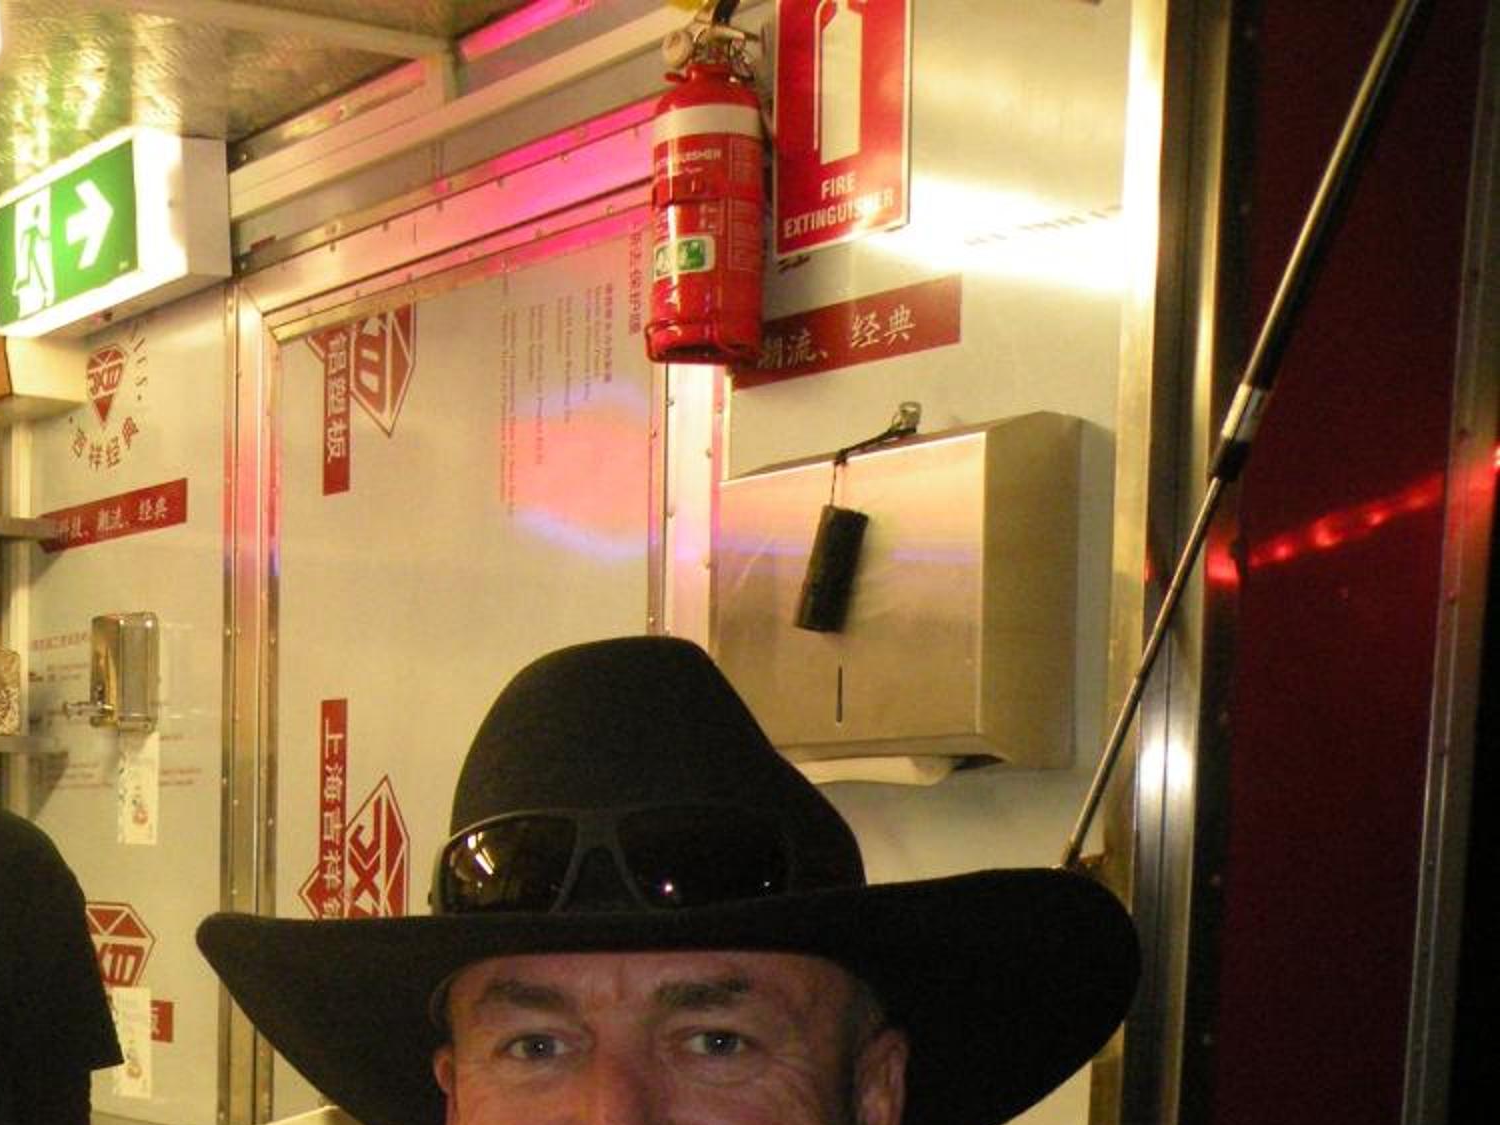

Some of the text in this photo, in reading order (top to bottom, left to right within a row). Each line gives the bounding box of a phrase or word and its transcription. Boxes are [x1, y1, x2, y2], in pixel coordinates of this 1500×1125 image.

[821, 171, 856, 200] FIRE
[850, 303, 917, 348] 经典
[327, 332, 347, 463] 铝塑板
